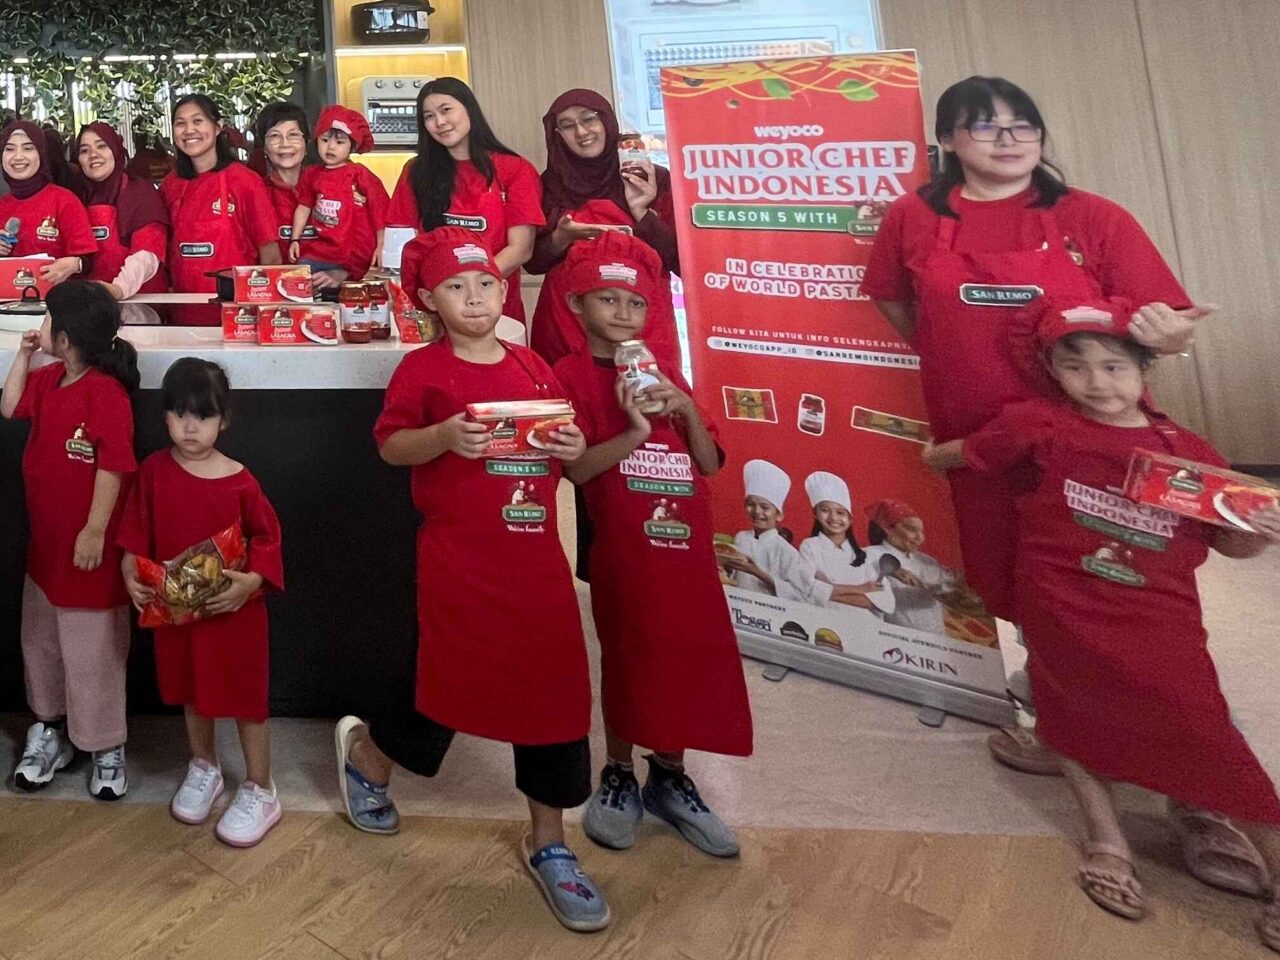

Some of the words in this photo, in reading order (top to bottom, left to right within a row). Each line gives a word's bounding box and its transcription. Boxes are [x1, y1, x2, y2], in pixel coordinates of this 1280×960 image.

[754, 124, 824, 140] weyoco
[687, 147, 807, 171] JUNIOR
[819, 147, 910, 168] CHEF
[702, 174, 900, 196] INDONESIA
[706, 210, 770, 223] SEASON
[777, 211, 787, 223] 5
[794, 212, 838, 224] WITH
[728, 260, 745, 273] IN
[753, 263, 866, 280] CELEBRATIO
[707, 275, 730, 287] OF
[734, 278, 798, 295] WORLD
[712, 326, 746, 336] FOLLOW
[749, 329, 769, 338] KITA
[772, 331, 803, 340] UNTUK
[806, 333, 830, 343] INFO
[833, 336, 912, 350] SELENGKAPNY
[816, 350, 920, 366] @SANREMOINDONESI
[631, 452, 666, 464] NIOR
[493, 464, 523, 473] SEASON
[622, 463, 692, 478] INDONESIA
[634, 481, 665, 491] SEASON
[1066, 483, 1131, 512] JUNIOR
[1070, 497, 1171, 536] INDONESIA
[732, 607, 772, 632] Tessa
[905, 652, 958, 676] KIRIN
